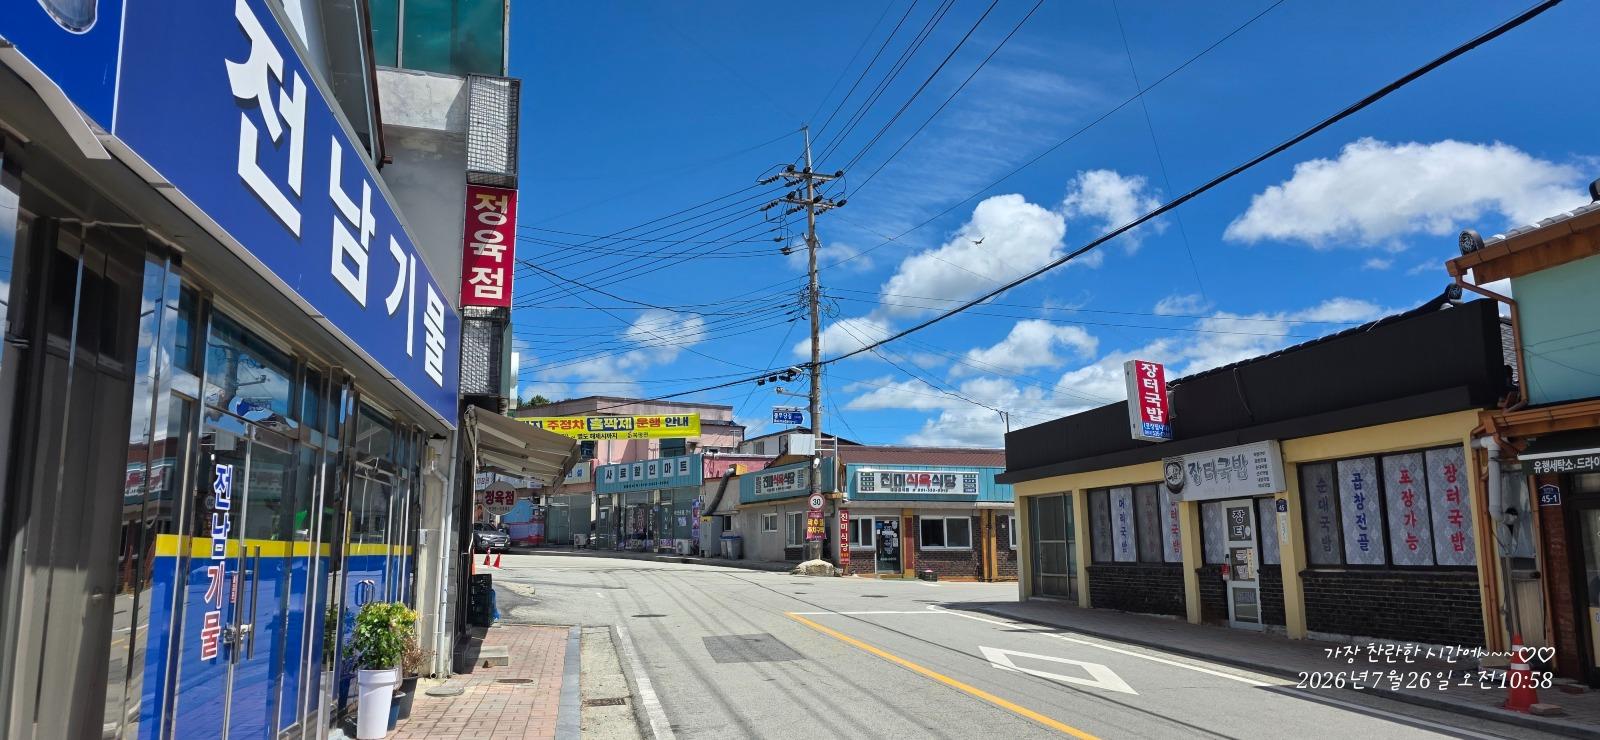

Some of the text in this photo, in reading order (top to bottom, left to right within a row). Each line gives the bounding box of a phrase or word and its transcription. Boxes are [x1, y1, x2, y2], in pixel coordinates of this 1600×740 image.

[224, 0, 445, 388] 전남기물
[469, 193, 508, 300] 정육점
[1141, 363, 1164, 422] 장터국밥
[547, 420, 585, 430] 주정차
[588, 417, 633, 431] 홀짝제
[636, 417, 661, 427] 운행
[664, 416, 689, 427] 안내
[485, 490, 514, 505] 정육점
[606, 461, 687, 479] 사료할인마트
[763, 472, 795, 488] 진미식육식당
[880, 473, 957, 489] 진미식육식당
[1188, 454, 1249, 486] 장터국밥
[812, 498, 821, 506] 30
[1119, 497, 1128, 553] 머리국밥
[1315, 477, 1332, 552] 순대국밥
[1351, 472, 1370, 552] 곱창전골
[1398, 469, 1419, 551] 포장가능
[1444, 463, 1466, 552] 장터국밥
[1541, 494, 1557, 503] 45-1
[840, 513, 849, 552] 진미식당
[1232, 509, 1249, 579] 장터국밥
[201, 464, 233, 661] 전남기물
